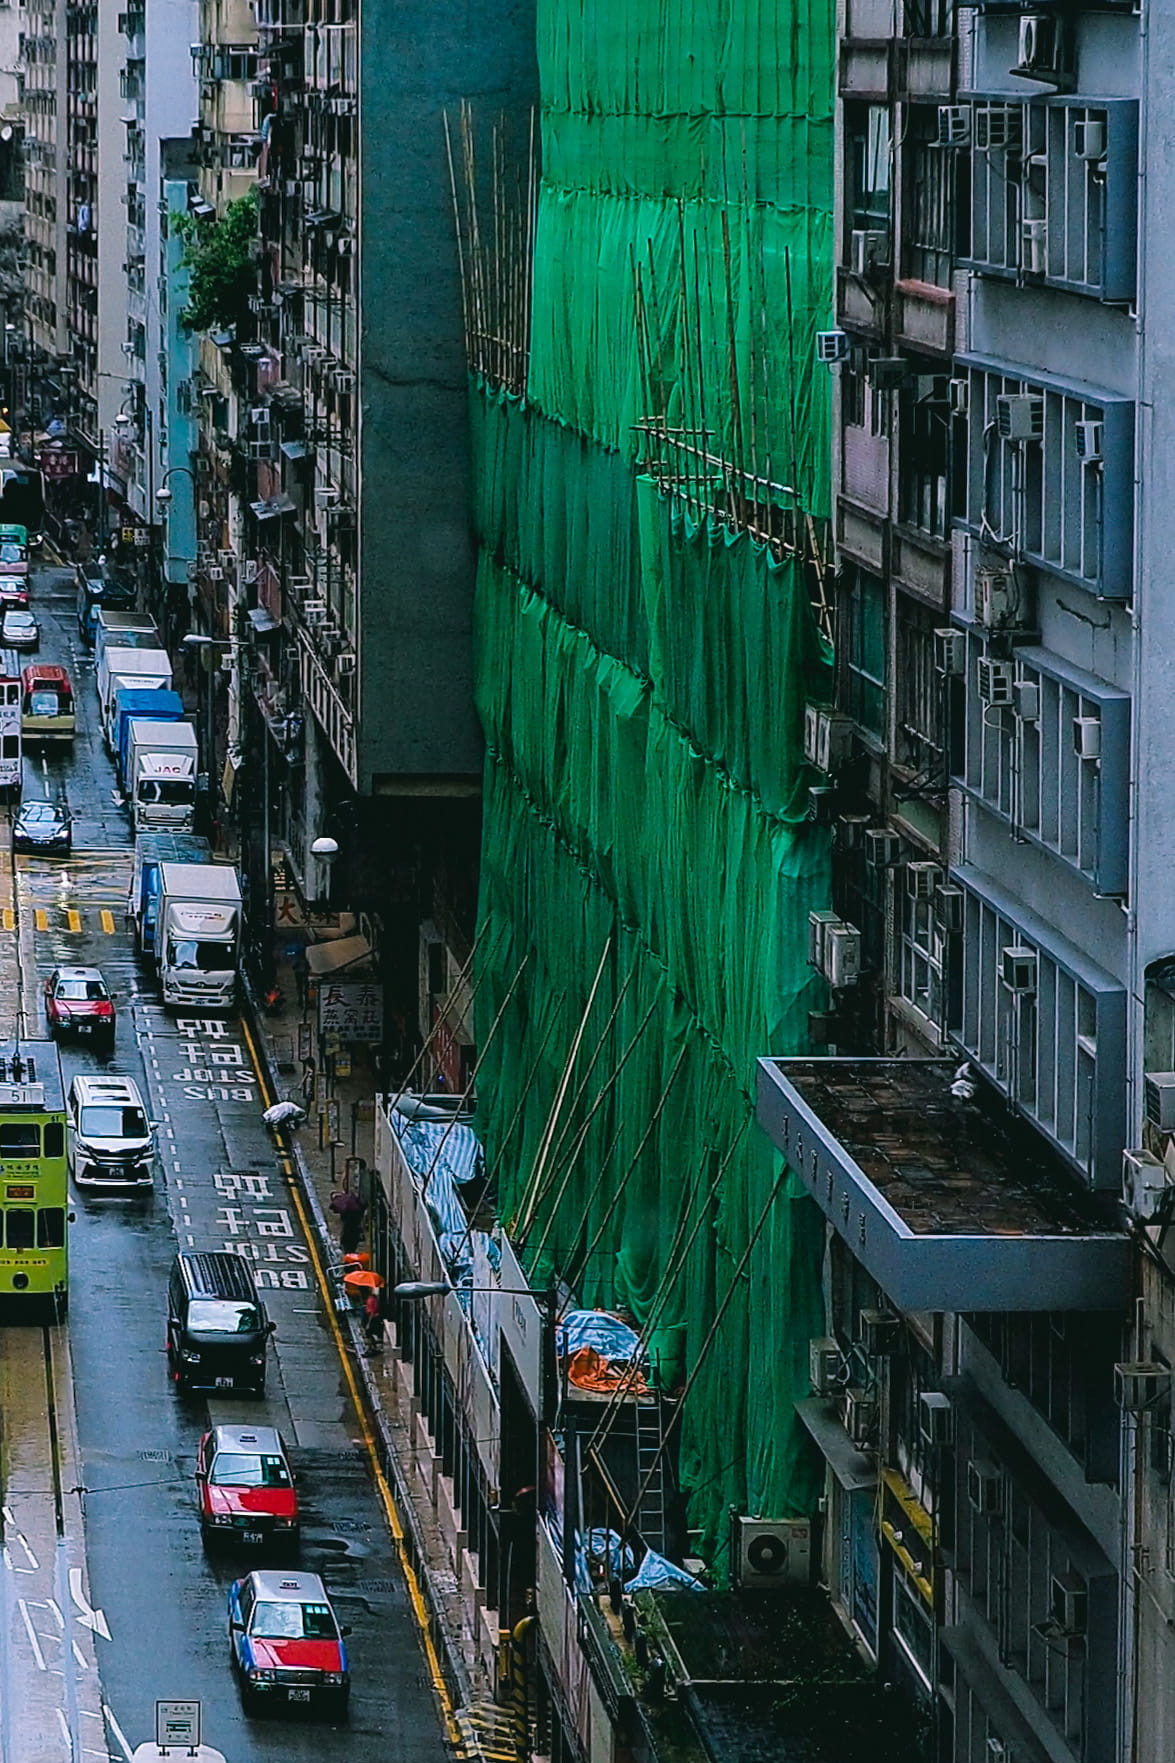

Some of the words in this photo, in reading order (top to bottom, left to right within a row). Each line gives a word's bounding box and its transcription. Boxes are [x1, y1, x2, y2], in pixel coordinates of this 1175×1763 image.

[154, 766, 181, 774] JAC
[176, 1018, 230, 1039] 站
[178, 1042, 243, 1065] 巴士
[173, 1068, 257, 1084] STOP
[11, 1090, 27, 1104] 51
[183, 1086, 254, 1102] BUS
[213, 1174, 274, 1201] 站
[216, 1207, 294, 1237] 巴士
[254, 1269, 309, 1288] BU
